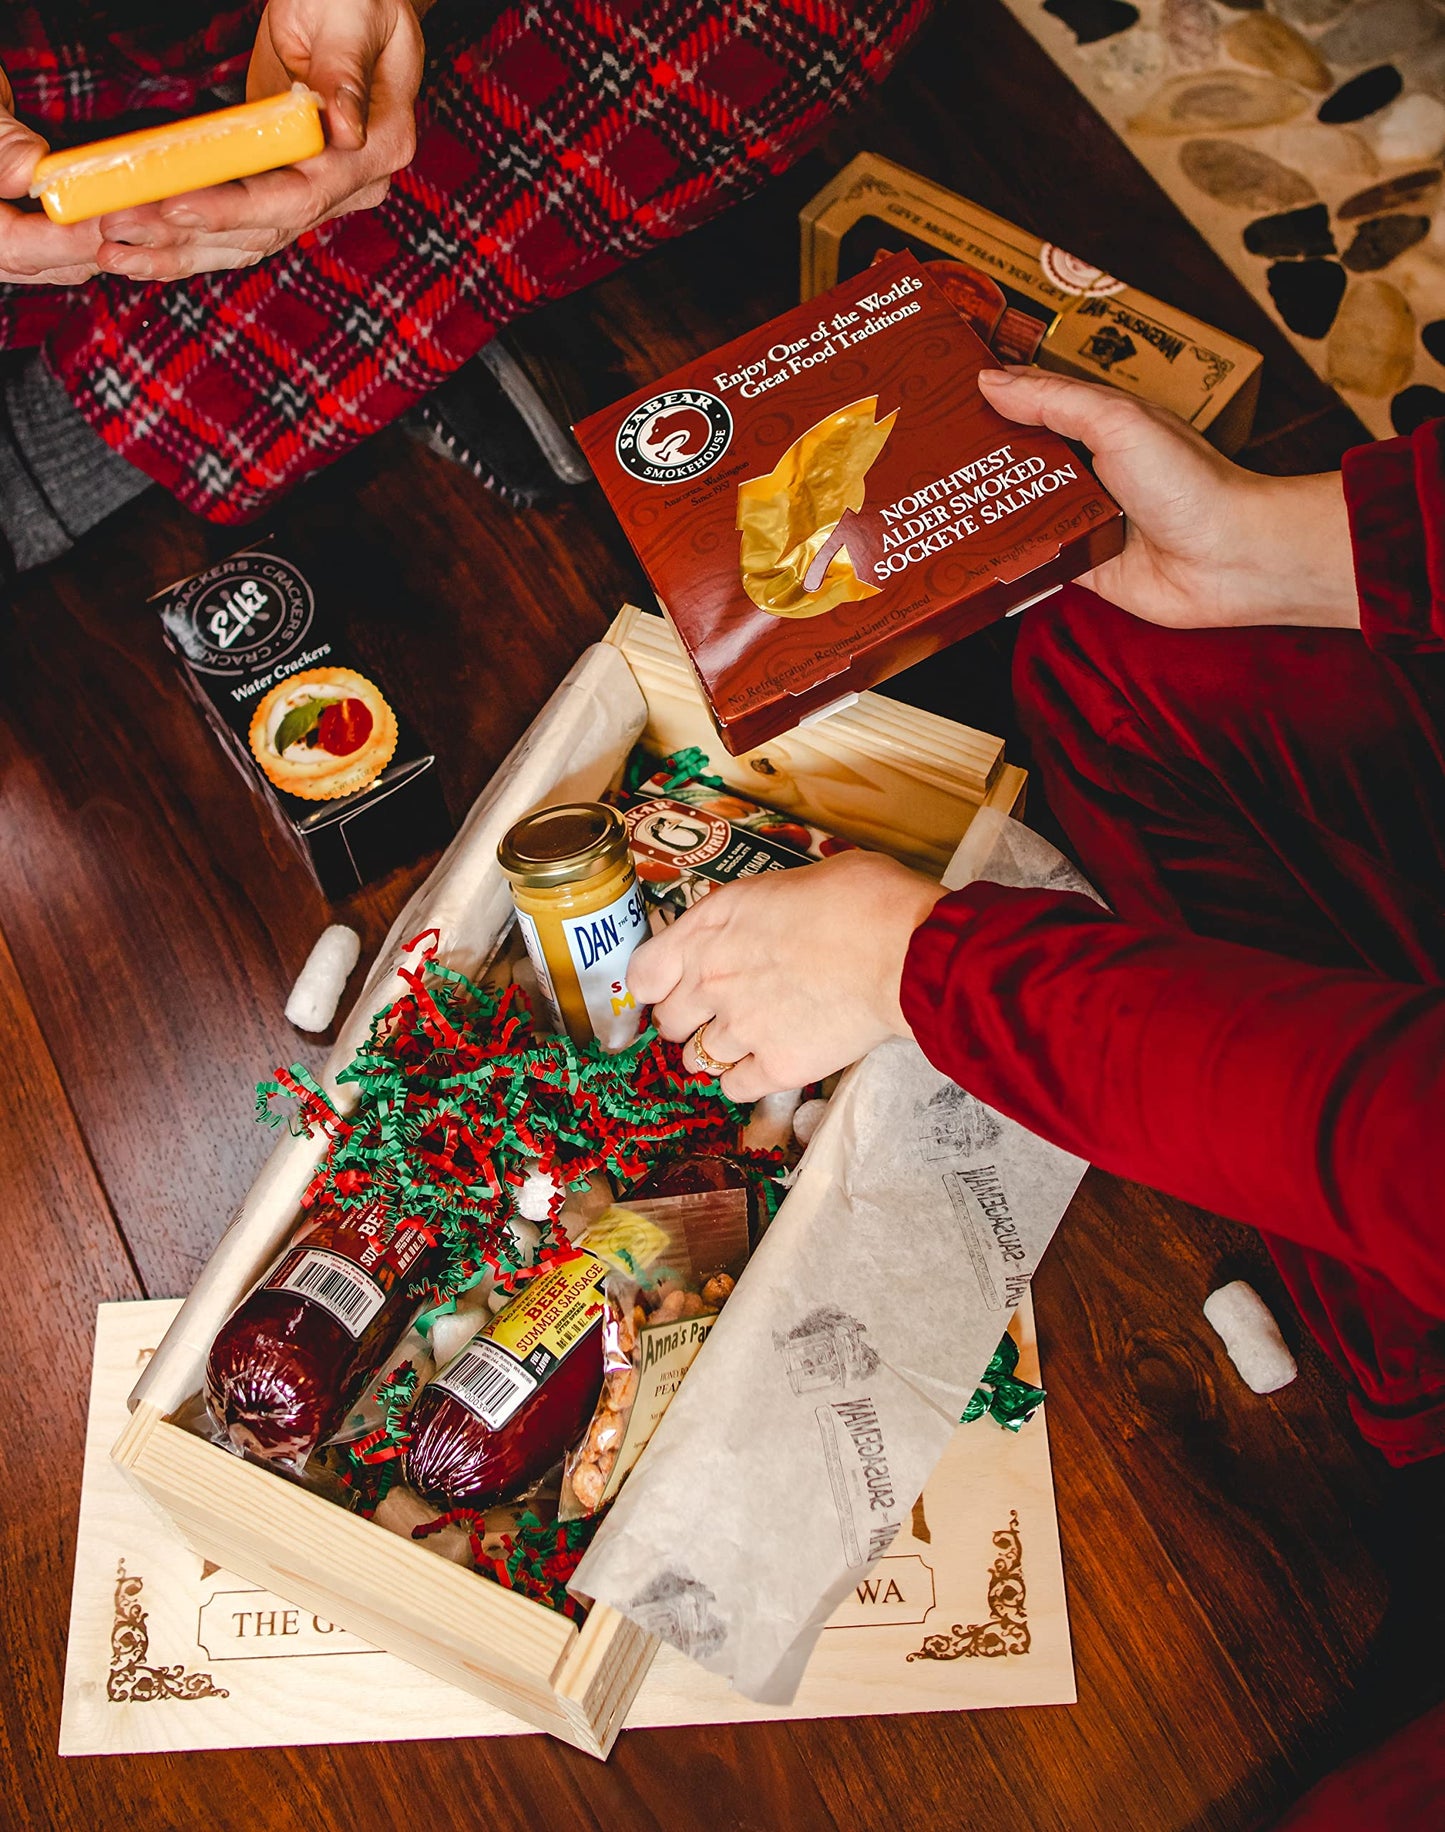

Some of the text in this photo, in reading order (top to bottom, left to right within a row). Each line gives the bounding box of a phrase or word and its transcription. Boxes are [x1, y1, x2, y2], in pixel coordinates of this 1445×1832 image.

[923, 221, 964, 247] MORE
[966, 242, 1005, 270] THAN
[712, 275, 924, 391] Enjoy One of the World's
[739, 301, 922, 398] Great Food Traditions
[620, 393, 713, 449] SEABEAR
[643, 429, 726, 479] SMOKEHOUSE
[703, 461, 750, 486] Washington
[691, 492, 713, 507] Since
[879, 445, 1017, 526] NORTHWEST
[881, 456, 1047, 553] ALDER SMOKED
[873, 464, 1079, 581] SOCKEYE SALMON
[967, 564, 990, 580] Net
[990, 543, 1028, 569] Weight
[210, 580, 270, 649] Elki
[261, 564, 304, 642] CRACKERS
[230, 644, 332, 702] Water Crackers
[727, 690, 745, 708] No
[747, 659, 814, 697] Refrigeration
[813, 630, 862, 663] Required
[861, 615, 890, 637] Until
[890, 594, 931, 621] Opened
[672, 820, 727, 866] CHERRIES
[715, 858, 730, 871] MILK
[723, 846, 753, 873] CHOCOLATE
[574, 914, 620, 971] DAN
[618, 915, 629, 928] THE
[502, 1290, 535, 1324] ROASTED
[516, 1263, 603, 1352] SUMMER SAUSAGE
[521, 1296, 536, 1312] RED
[536, 1270, 563, 1297] PEPPER
[524, 1276, 569, 1321] BEEF
[556, 1320, 570, 1335] AFTER
[643, 1325, 687, 1374] Anna's
[529, 1350, 542, 1366] FULL
[535, 1352, 552, 1376] FLAVOR
[655, 1380, 682, 1397] PEA
[232, 1610, 300, 1638] THE
